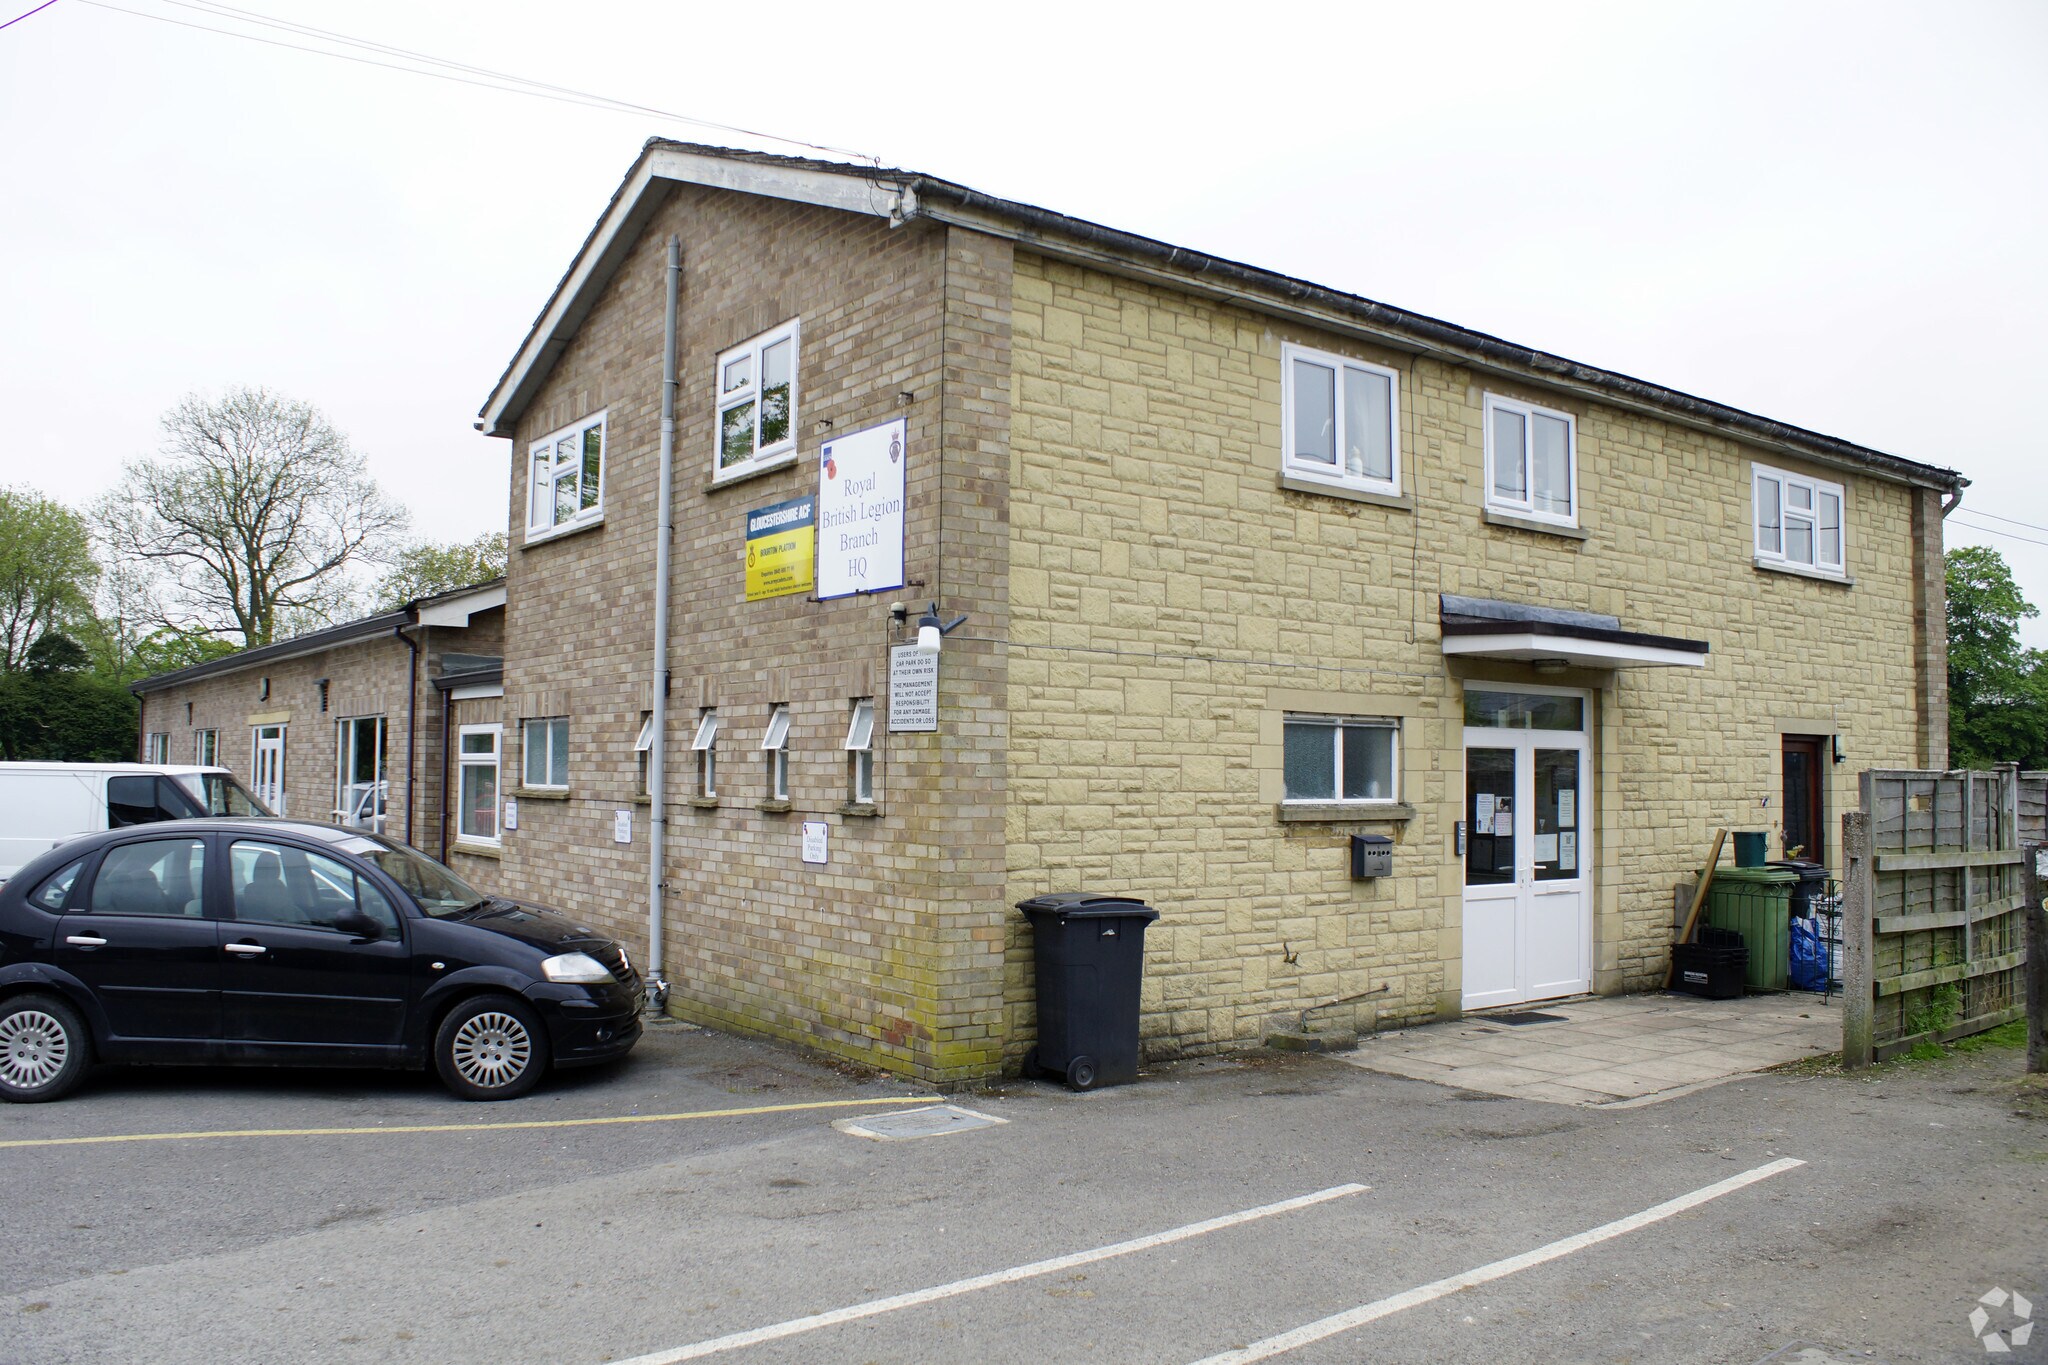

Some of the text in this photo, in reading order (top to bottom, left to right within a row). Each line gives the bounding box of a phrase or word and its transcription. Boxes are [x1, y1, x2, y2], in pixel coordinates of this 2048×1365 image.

[844, 472, 876, 498] Royal
[750, 503, 811, 532] GLOUCESTERSHIRE ACF
[822, 496, 900, 529] British Legion
[778, 541, 797, 553] PLATOON
[840, 527, 878, 551] Branch
[848, 556, 868, 579] HQ
[897, 650, 912, 658] USERS
[905, 659, 916, 667] PARK
[902, 680, 933, 688] MANAGEMENT
